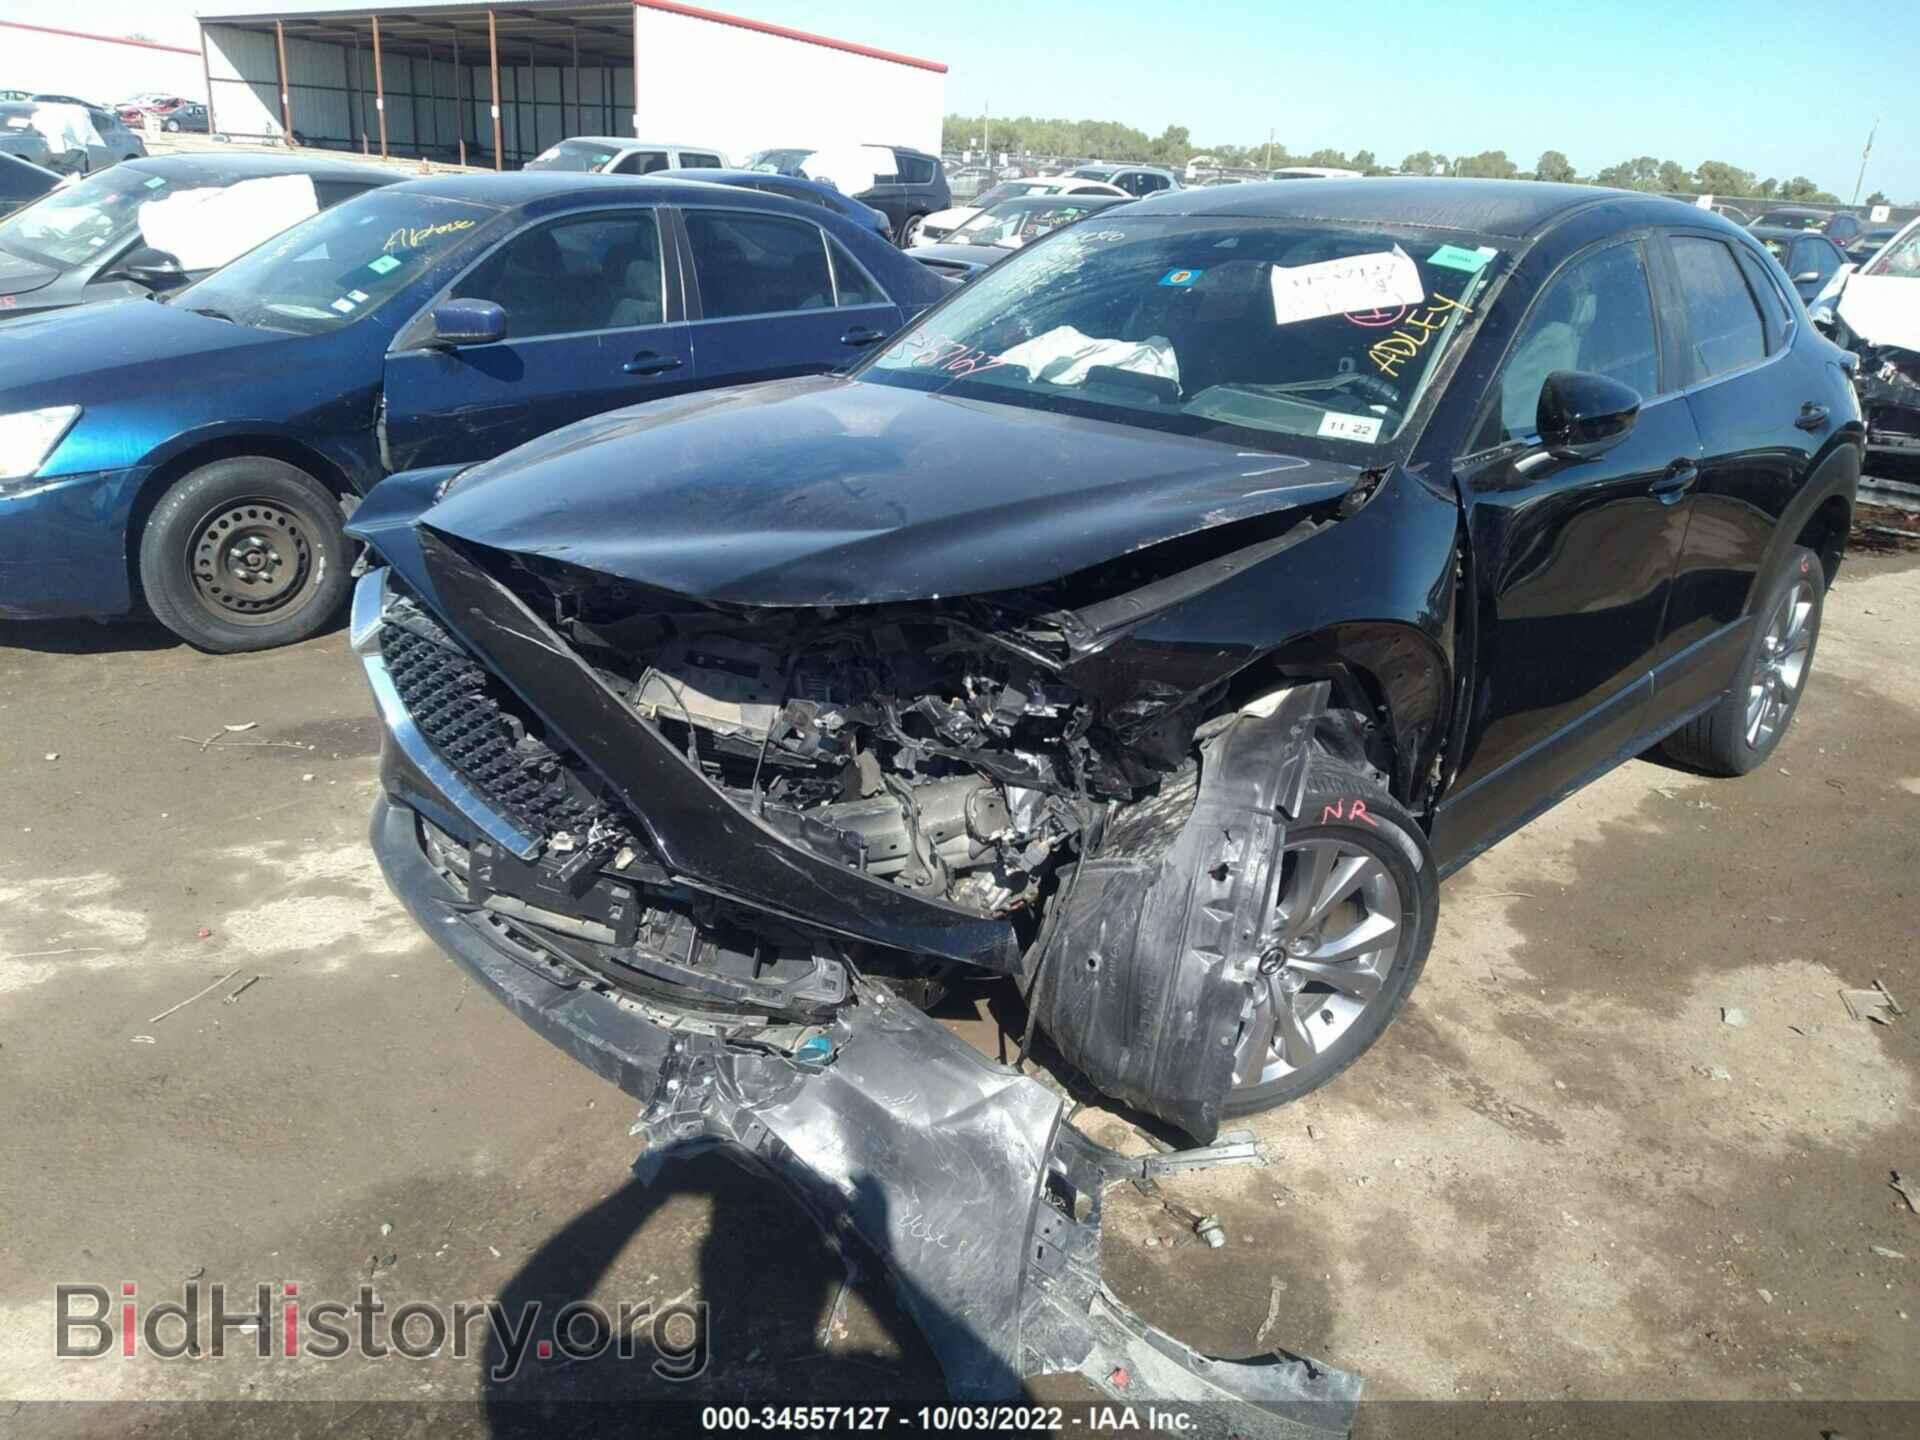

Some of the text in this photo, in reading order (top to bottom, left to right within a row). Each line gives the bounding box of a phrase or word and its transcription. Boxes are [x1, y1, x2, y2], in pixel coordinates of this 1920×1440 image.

[1368, 292, 1474, 377] ADLEY
[1352, 424, 1371, 435] 22
[1321, 798, 1377, 826] NR
